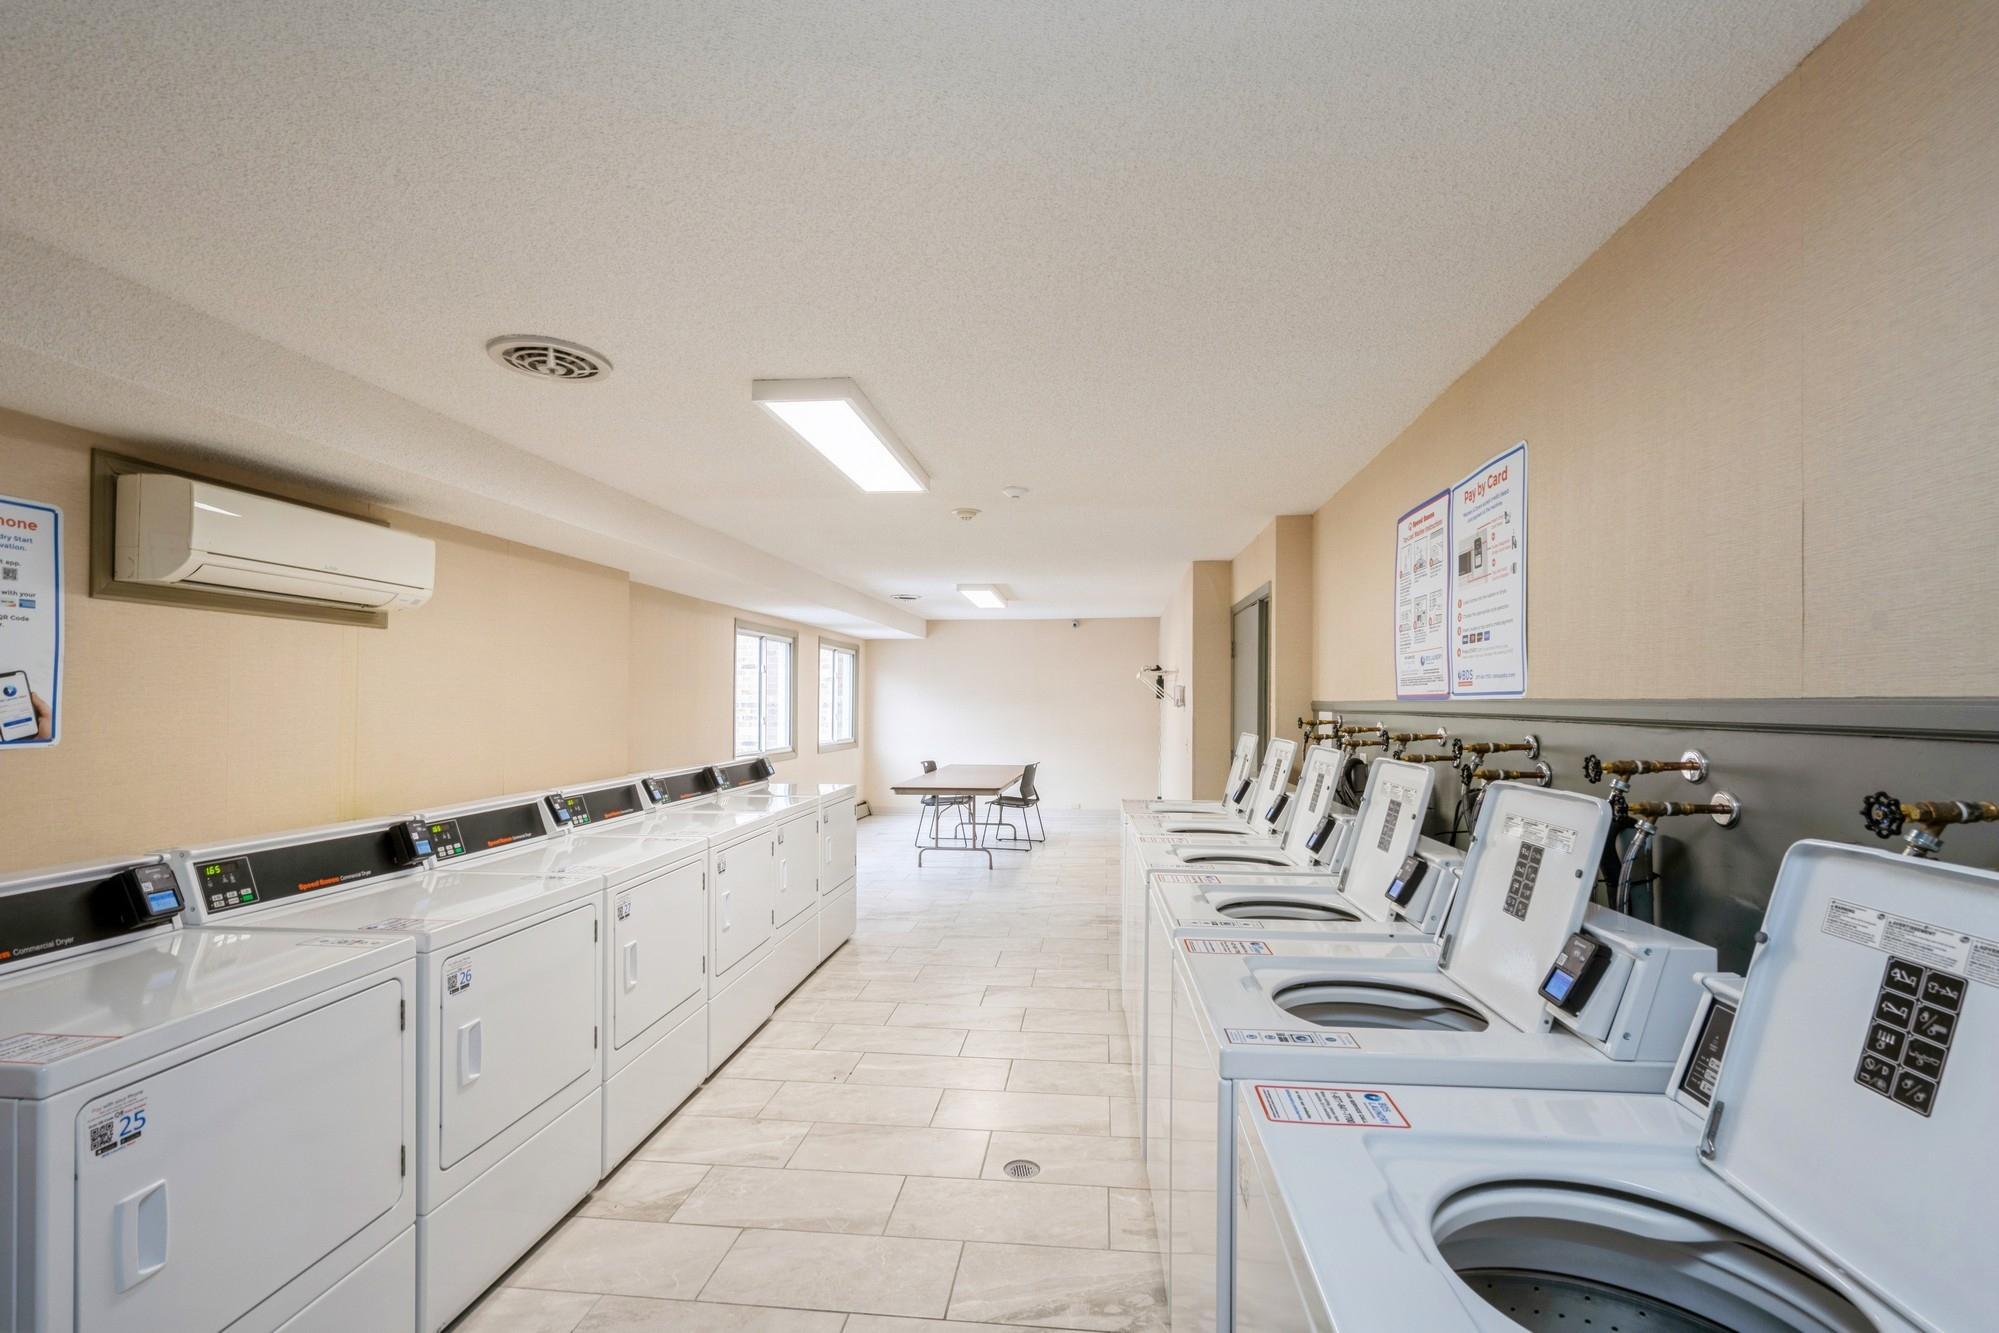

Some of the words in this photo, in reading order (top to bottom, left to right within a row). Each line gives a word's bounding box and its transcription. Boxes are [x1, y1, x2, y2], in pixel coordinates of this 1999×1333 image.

[1464, 487, 1476, 504] Pay
[1477, 480, 1486, 497] by
[1487, 465, 1508, 489] Card
[13, 535, 33, 544] Start
[12, 940, 55, 956] Commercial
[55, 936, 75, 946] Dryer
[460, 969, 472, 985] 26
[119, 1109, 146, 1138] 25
